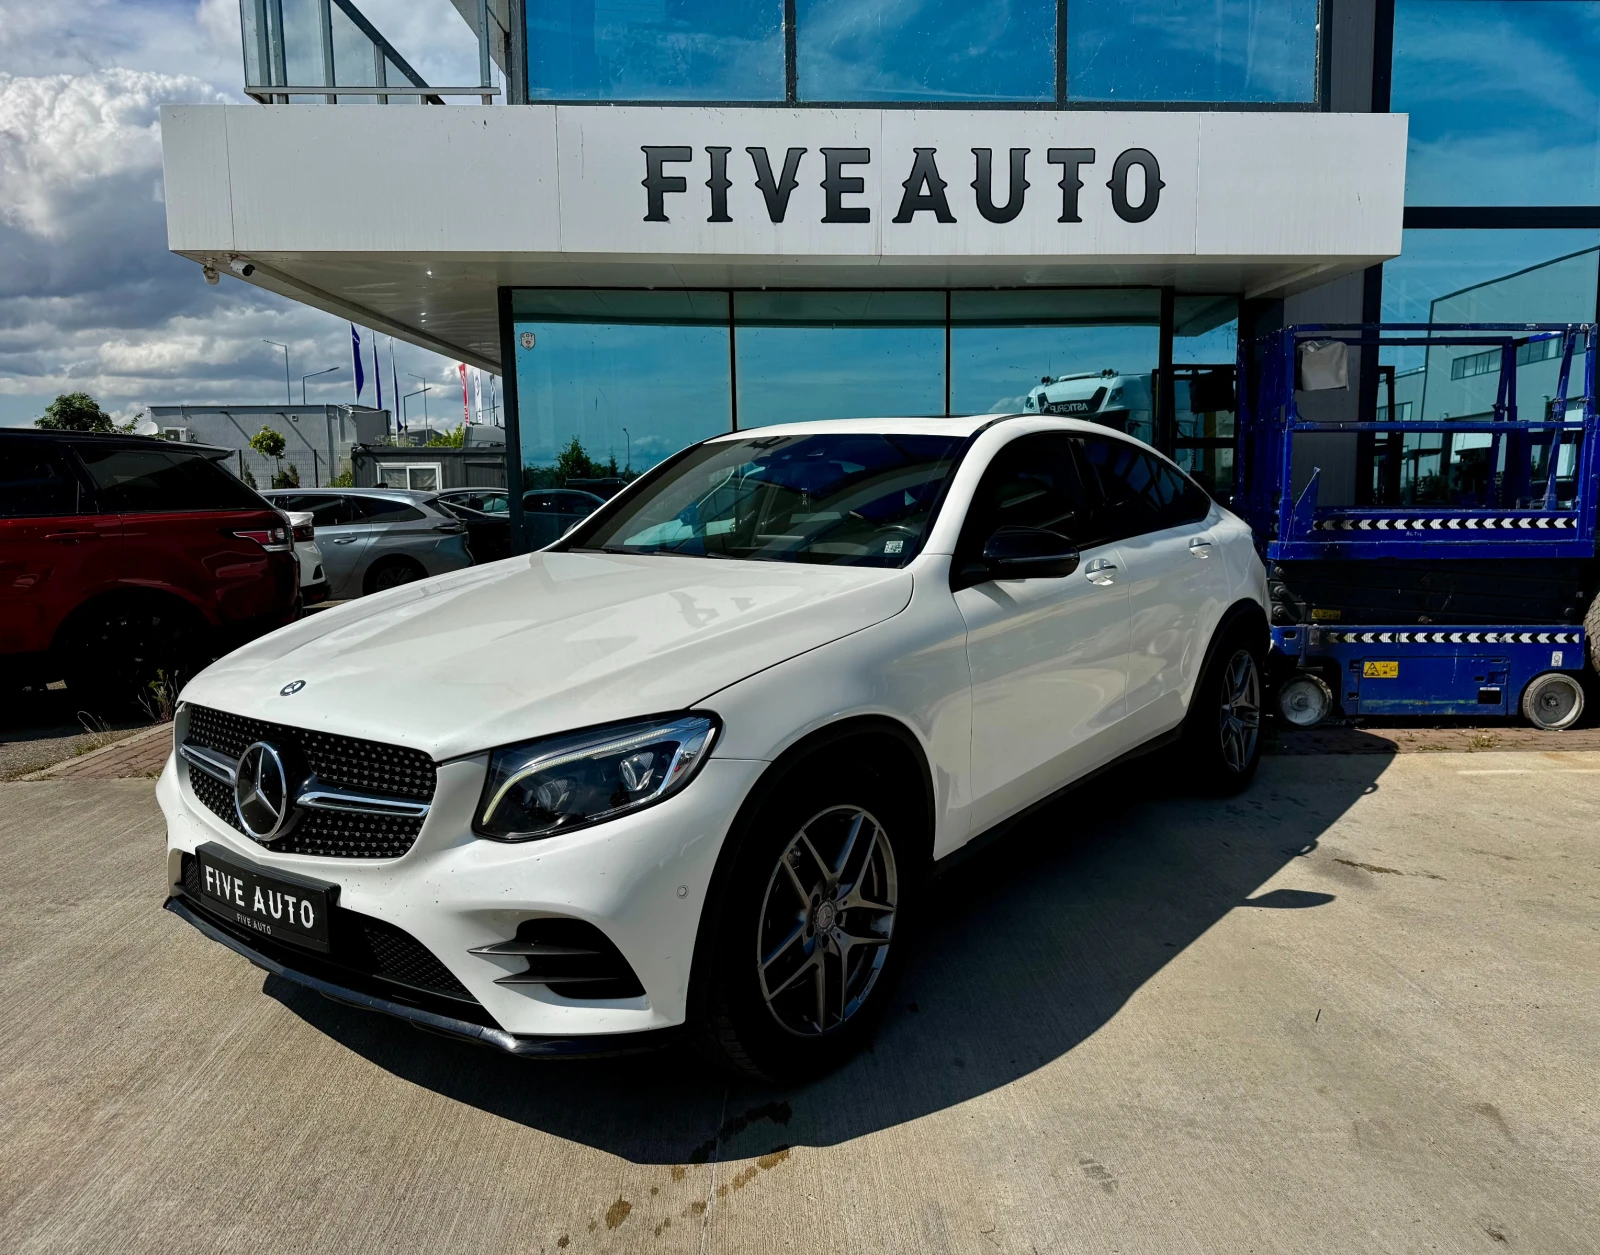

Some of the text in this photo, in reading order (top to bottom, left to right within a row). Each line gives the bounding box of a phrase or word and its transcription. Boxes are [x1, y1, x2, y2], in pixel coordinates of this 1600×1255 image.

[205, 865, 314, 928] FIVE AUTO
[237, 914, 272, 935] FIVE AUTO
